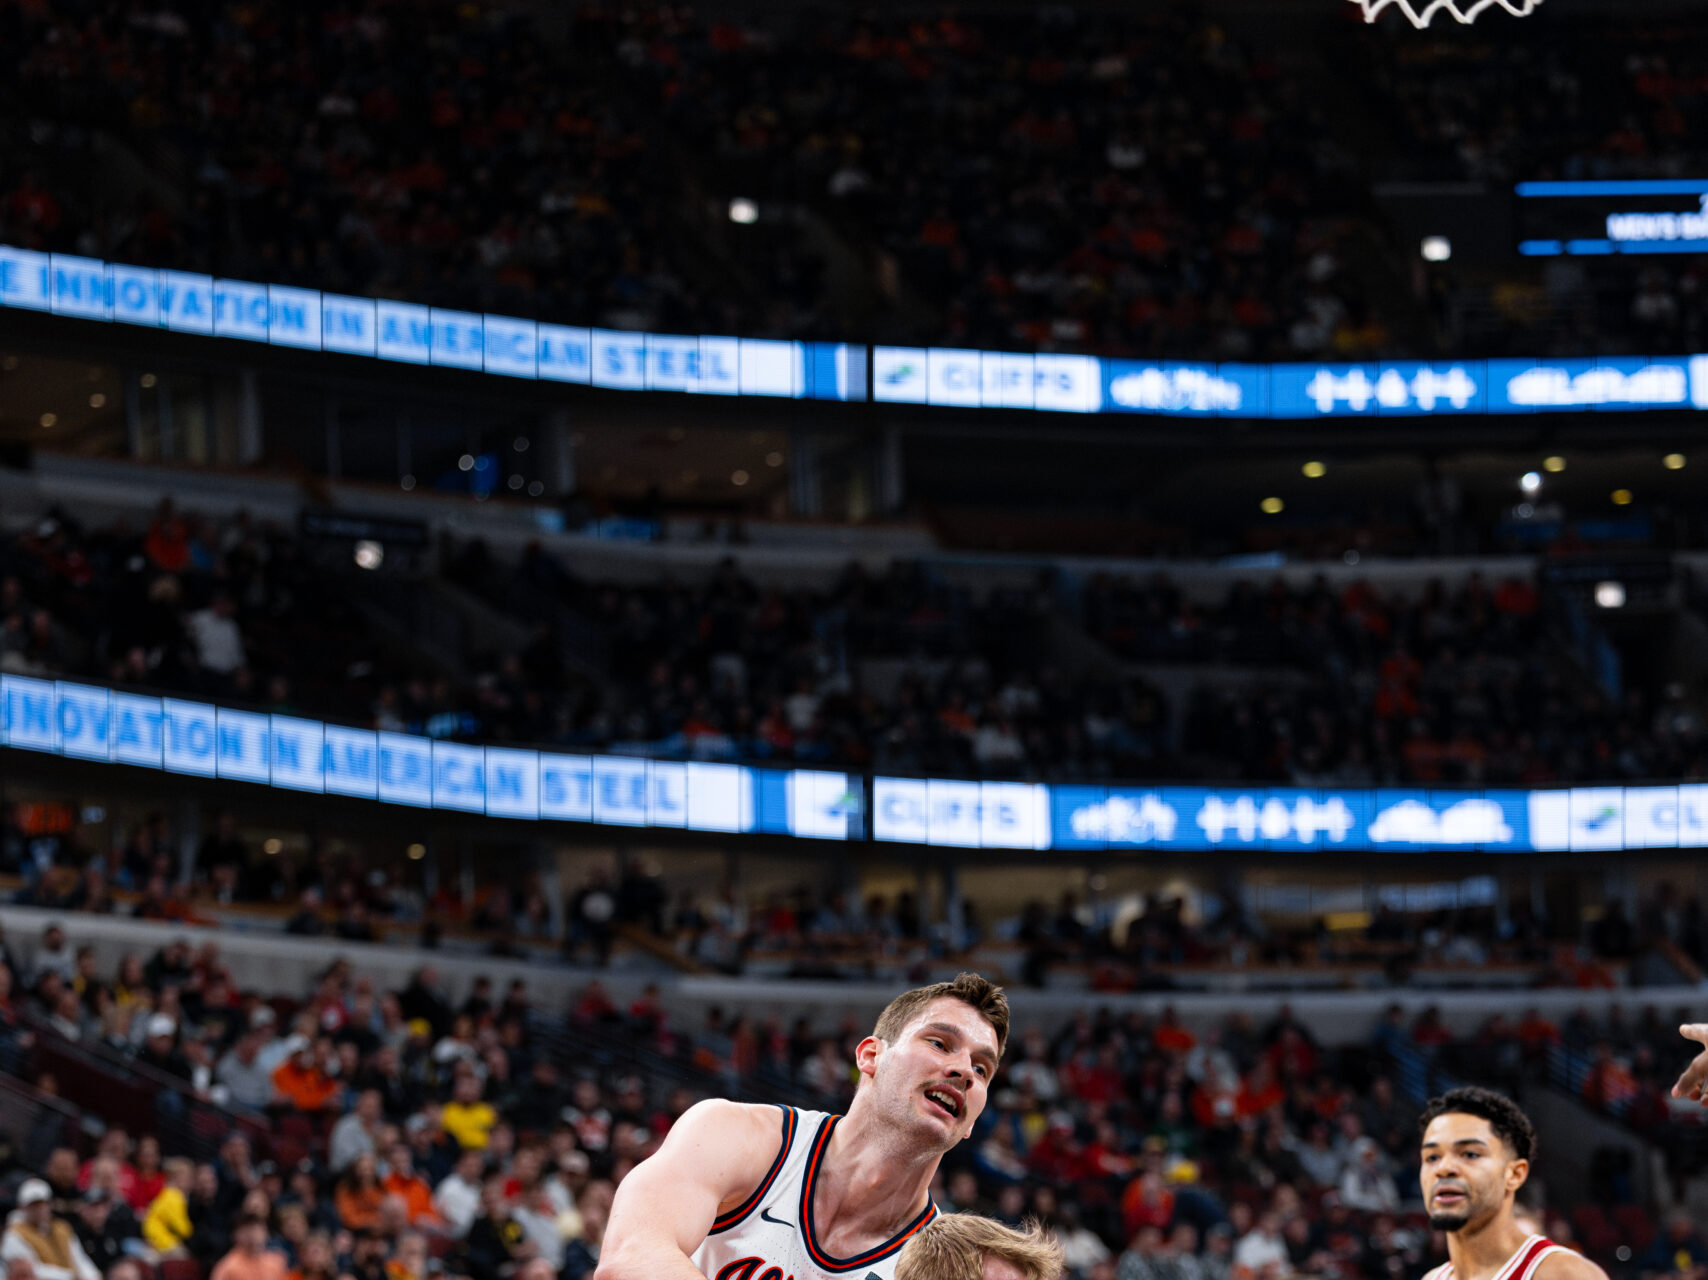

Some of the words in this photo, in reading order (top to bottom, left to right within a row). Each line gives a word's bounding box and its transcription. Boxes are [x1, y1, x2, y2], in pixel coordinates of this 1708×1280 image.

[39, 266, 307, 332] INNOVATION
[325, 308, 364, 339] IN
[383, 314, 587, 367] AMERICAN
[607, 346, 740, 381] STEEL
[260, 730, 301, 768] IN
[318, 741, 523, 801] AMERICAN
[544, 768, 679, 811] STEEL
